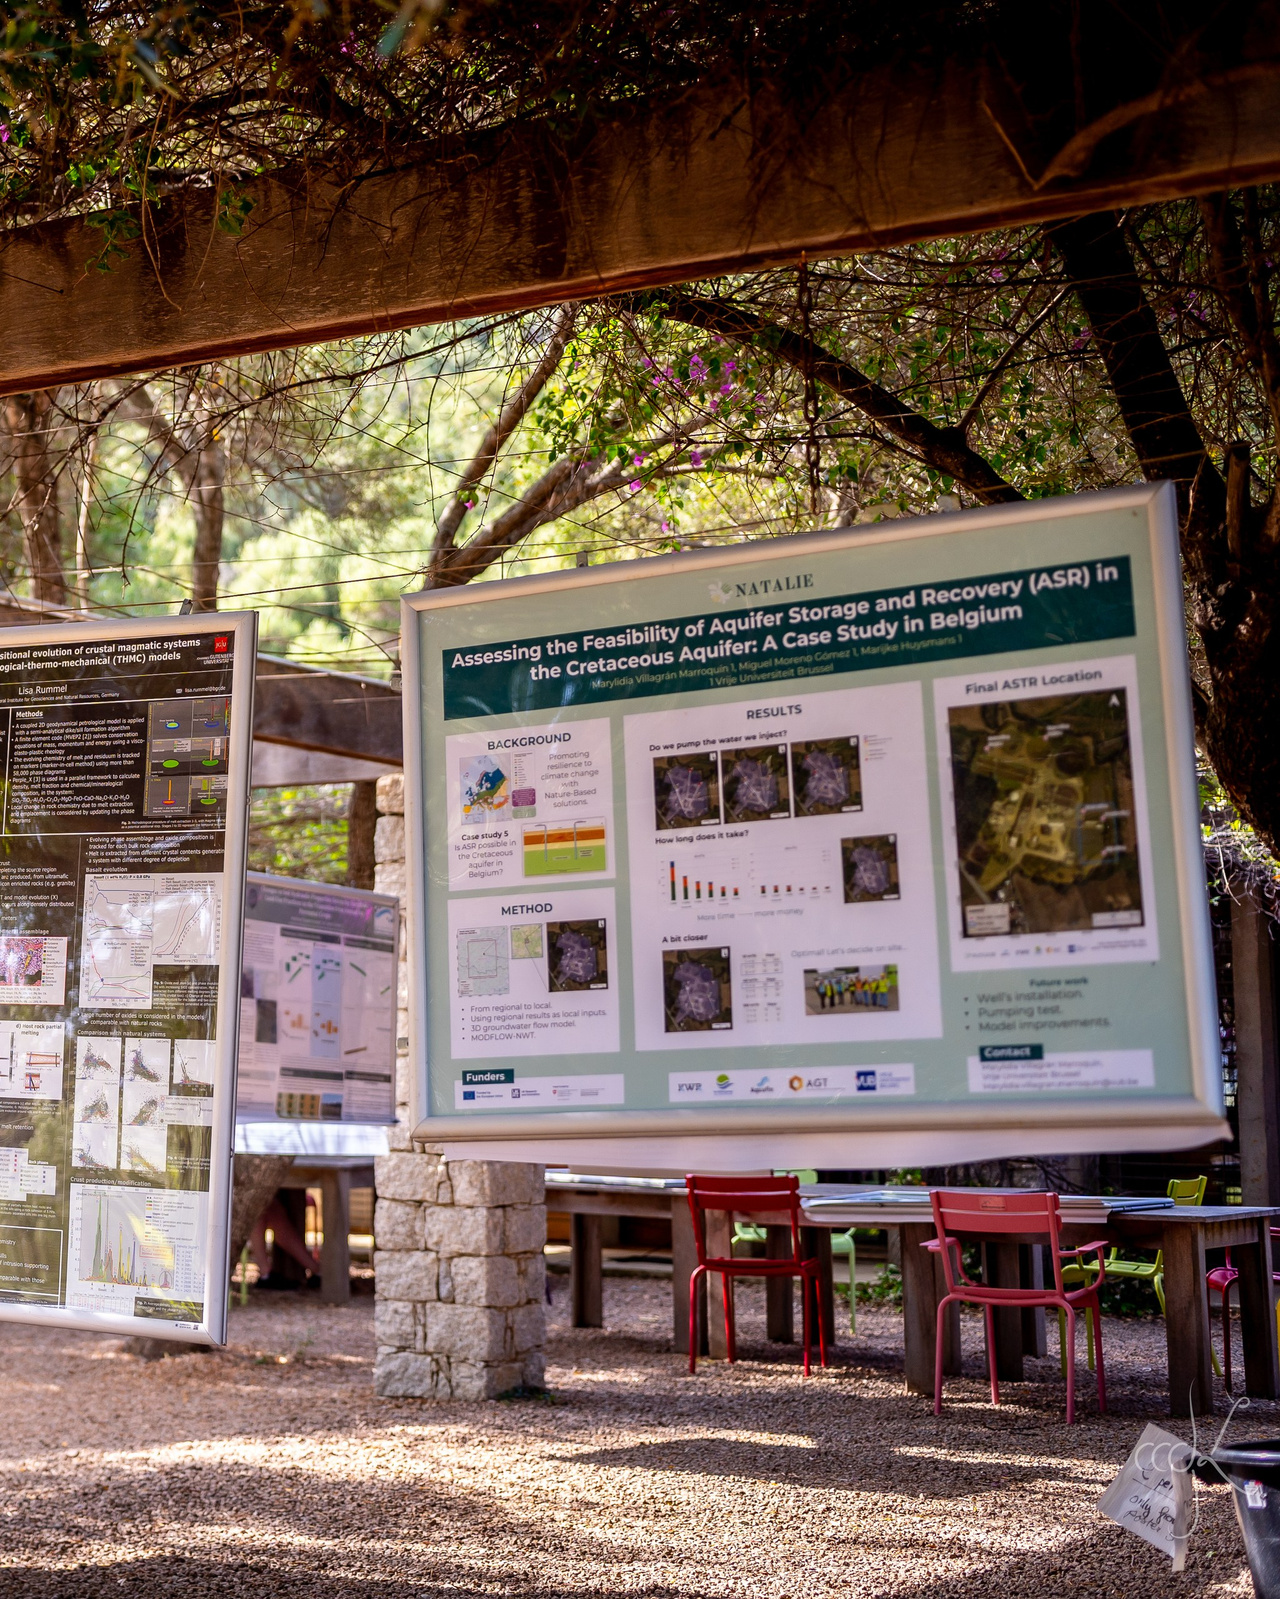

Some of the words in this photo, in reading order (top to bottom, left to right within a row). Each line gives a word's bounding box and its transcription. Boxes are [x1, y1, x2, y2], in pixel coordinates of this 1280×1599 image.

[735, 574, 813, 597] NATALIE
[451, 643, 541, 668] Assessing
[545, 638, 578, 655] the
[582, 624, 680, 651] Feasibility
[684, 618, 705, 637] of
[708, 610, 783, 634] Aquifer
[788, 600, 870, 623] Storage
[875, 590, 915, 612] and
[921, 579, 1023, 606] Recovery
[1029, 566, 1089, 595] (ASR)
[1096, 563, 1118, 581] in
[32, 647, 72, 658] evolution
[74, 645, 84, 655] of
[84, 643, 115, 654] crustal
[117, 640, 161, 653] magmatic
[163, 639, 201, 651] systems
[529, 663, 561, 680] the
[566, 651, 674, 676] Cretaceous
[678, 638, 757, 663] Aquifer:
[761, 634, 778, 651] A
[782, 630, 832, 648] Case
[836, 618, 898, 642] Study
[903, 615, 924, 633] in
[930, 605, 1022, 629] Belgium
[112, 653, 146, 666] (THMC)
[148, 651, 181, 661] models
[738, 658, 772, 671] Miguel
[773, 654, 813, 666] Moreno
[860, 643, 899, 655] Marijke
[900, 636, 956, 650] Huysmans
[965, 680, 998, 694] Final
[1001, 676, 1037, 690] ASTR
[1041, 670, 1102, 686] Location
[18, 686, 33, 695] Lisa
[35, 683, 67, 694] Rummel
[15, 709, 43, 717] Methods
[746, 704, 802, 719] RESULTS
[487, 732, 571, 750] BACKGROUND
[676, 740, 701, 750] pump
[702, 738, 716, 746] the
[718, 735, 742, 744] water
[758, 729, 787, 740] inject?
[548, 751, 590, 760] Promoting
[546, 761, 583, 770] resilience
[540, 772, 569, 781] climate
[569, 769, 599, 778] change
[561, 779, 579, 788] with
[544, 787, 597, 799] Nature-Based
[552, 798, 588, 808] solutions.
[480, 830, 502, 839] study
[675, 835, 694, 843] long
[695, 833, 716, 841] does
[725, 829, 749, 838] take?
[461, 842, 477, 850] ASR
[477, 840, 508, 850] possible
[457, 852, 470, 860] the
[471, 849, 513, 859] Cretaceous
[468, 859, 494, 870] aquifer
[468, 868, 503, 878] Belgium?
[501, 902, 553, 915] METHOD
[683, 934, 708, 942] closer
[1029, 979, 1062, 987] Future
[1064, 977, 1088, 985] work
[977, 992, 1012, 1003] Well's
[1014, 989, 1084, 1001] installation.
[470, 1005, 490, 1013] From
[491, 1003, 522, 1013] regional
[533, 1001, 552, 1009] local.
[977, 1006, 1035, 1018] Pumping
[1036, 1004, 1064, 1015] test.
[470, 1014, 492, 1023] Using
[493, 1012, 524, 1022] regional
[525, 1011, 551, 1019] results
[561, 1009, 579, 1017] local
[580, 1009, 606, 1017] inputs.
[470, 1024, 481, 1032] 3D
[482, 1023, 531, 1033] groundwater
[532, 1021, 549, 1029] flow
[550, 1020, 576, 1028] model.
[978, 1021, 1016, 1031] Model
[1018, 1017, 1112, 1031] improvements.
[470, 1031, 536, 1041] MODFLOW-NWT.
[984, 1047, 1030, 1057] Contact
[466, 1072, 505, 1082] Funders
[805, 1077, 827, 1087] AGT
[85, 1177, 151, 1188] production/modification
